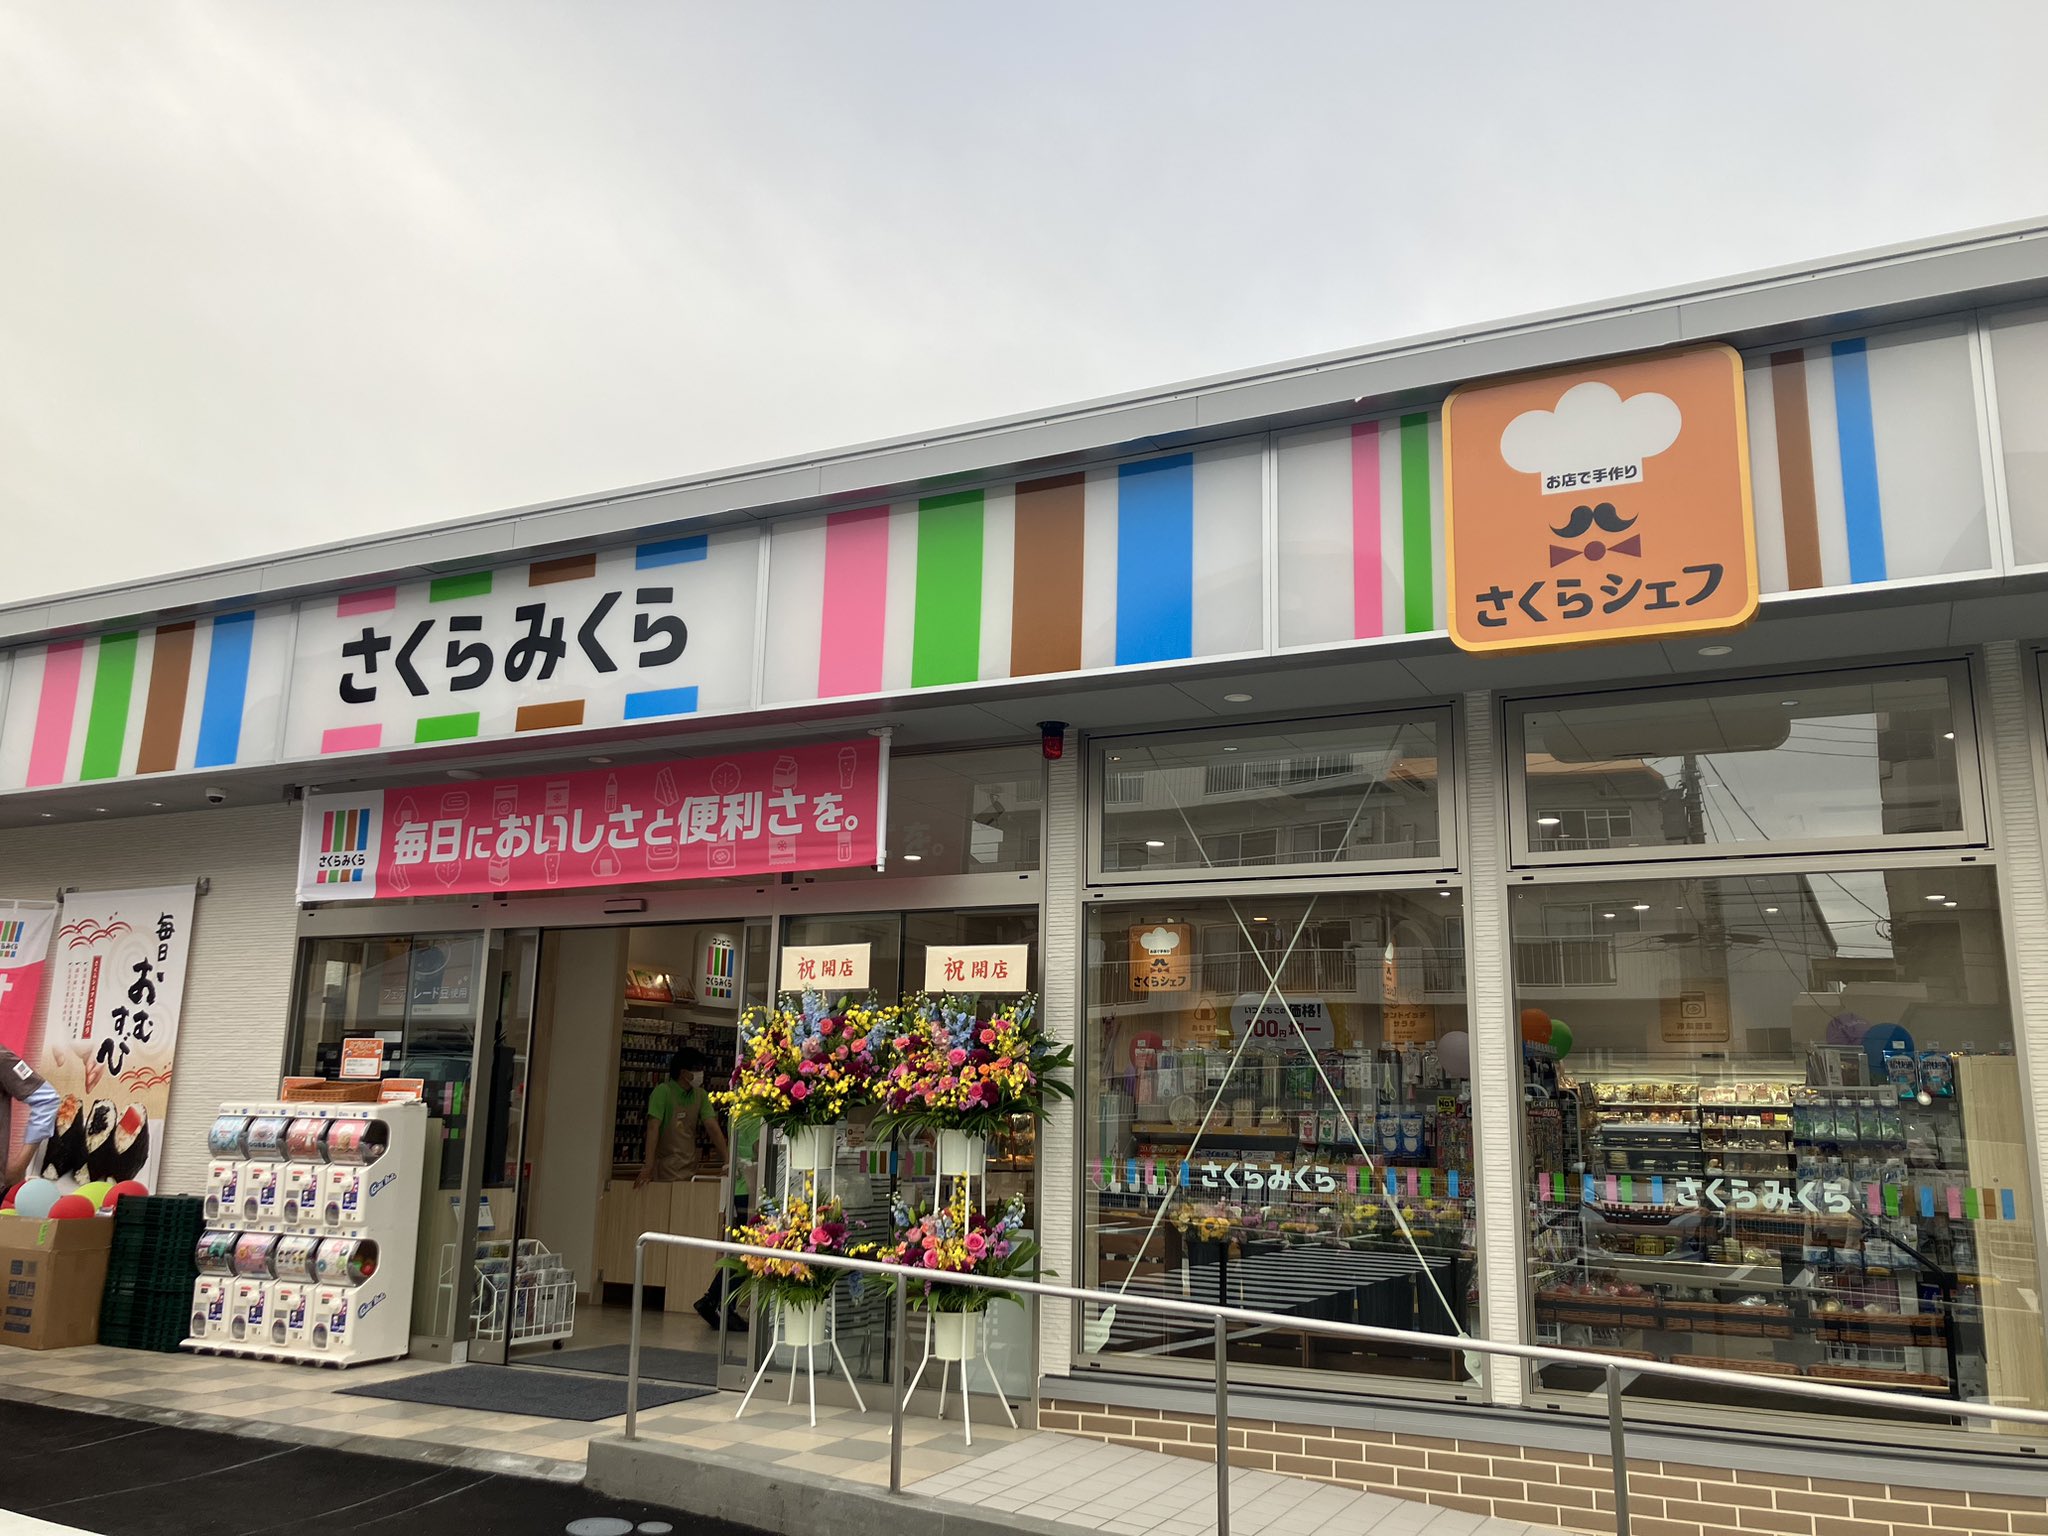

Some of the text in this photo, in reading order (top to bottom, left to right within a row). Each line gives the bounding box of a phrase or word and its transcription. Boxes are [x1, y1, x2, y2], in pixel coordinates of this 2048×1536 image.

[1546, 465, 1638, 490] お店で手作り
[1476, 563, 1724, 627] さくらシェフ
[339, 587, 688, 704] さくらみくら
[393, 788, 859, 865] 毎日においしさと便利さを。
[319, 853, 366, 867] さくらみくら
[156, 912, 175, 961] 毎日
[712, 938, 732, 947] コンビニ
[383, 986, 467, 1000] フェアレード豆使用
[706, 977, 733, 987] さくらみくら
[1134, 976, 1187, 988] さくらシェフ
[1201, 1161, 1336, 1193] さくらみくら
[1676, 1176, 1852, 1213] さくらみくら
